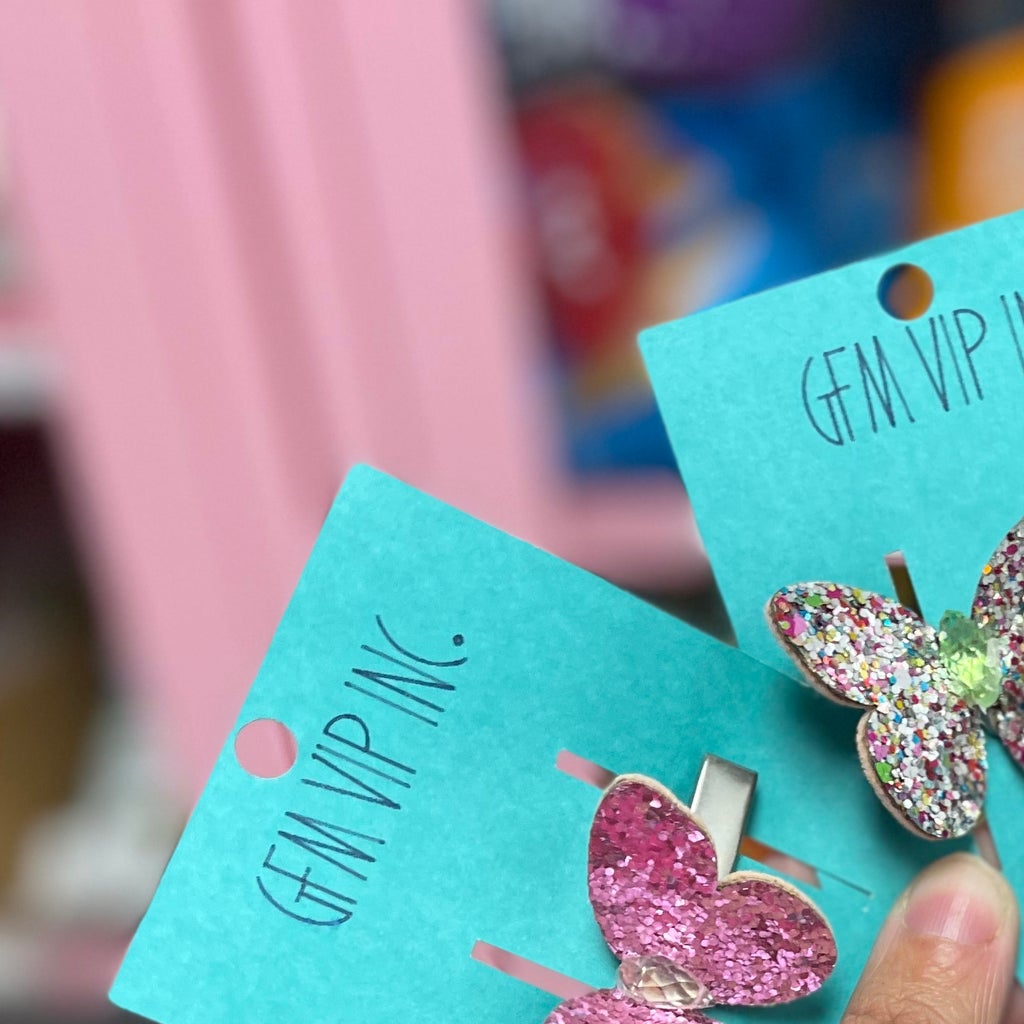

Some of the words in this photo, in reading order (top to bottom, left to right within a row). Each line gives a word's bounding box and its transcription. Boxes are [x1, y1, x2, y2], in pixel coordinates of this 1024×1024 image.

[905, 308, 987, 411] VIP
[344, 614, 468, 727] INC.
[300, 713, 416, 809] VIP
